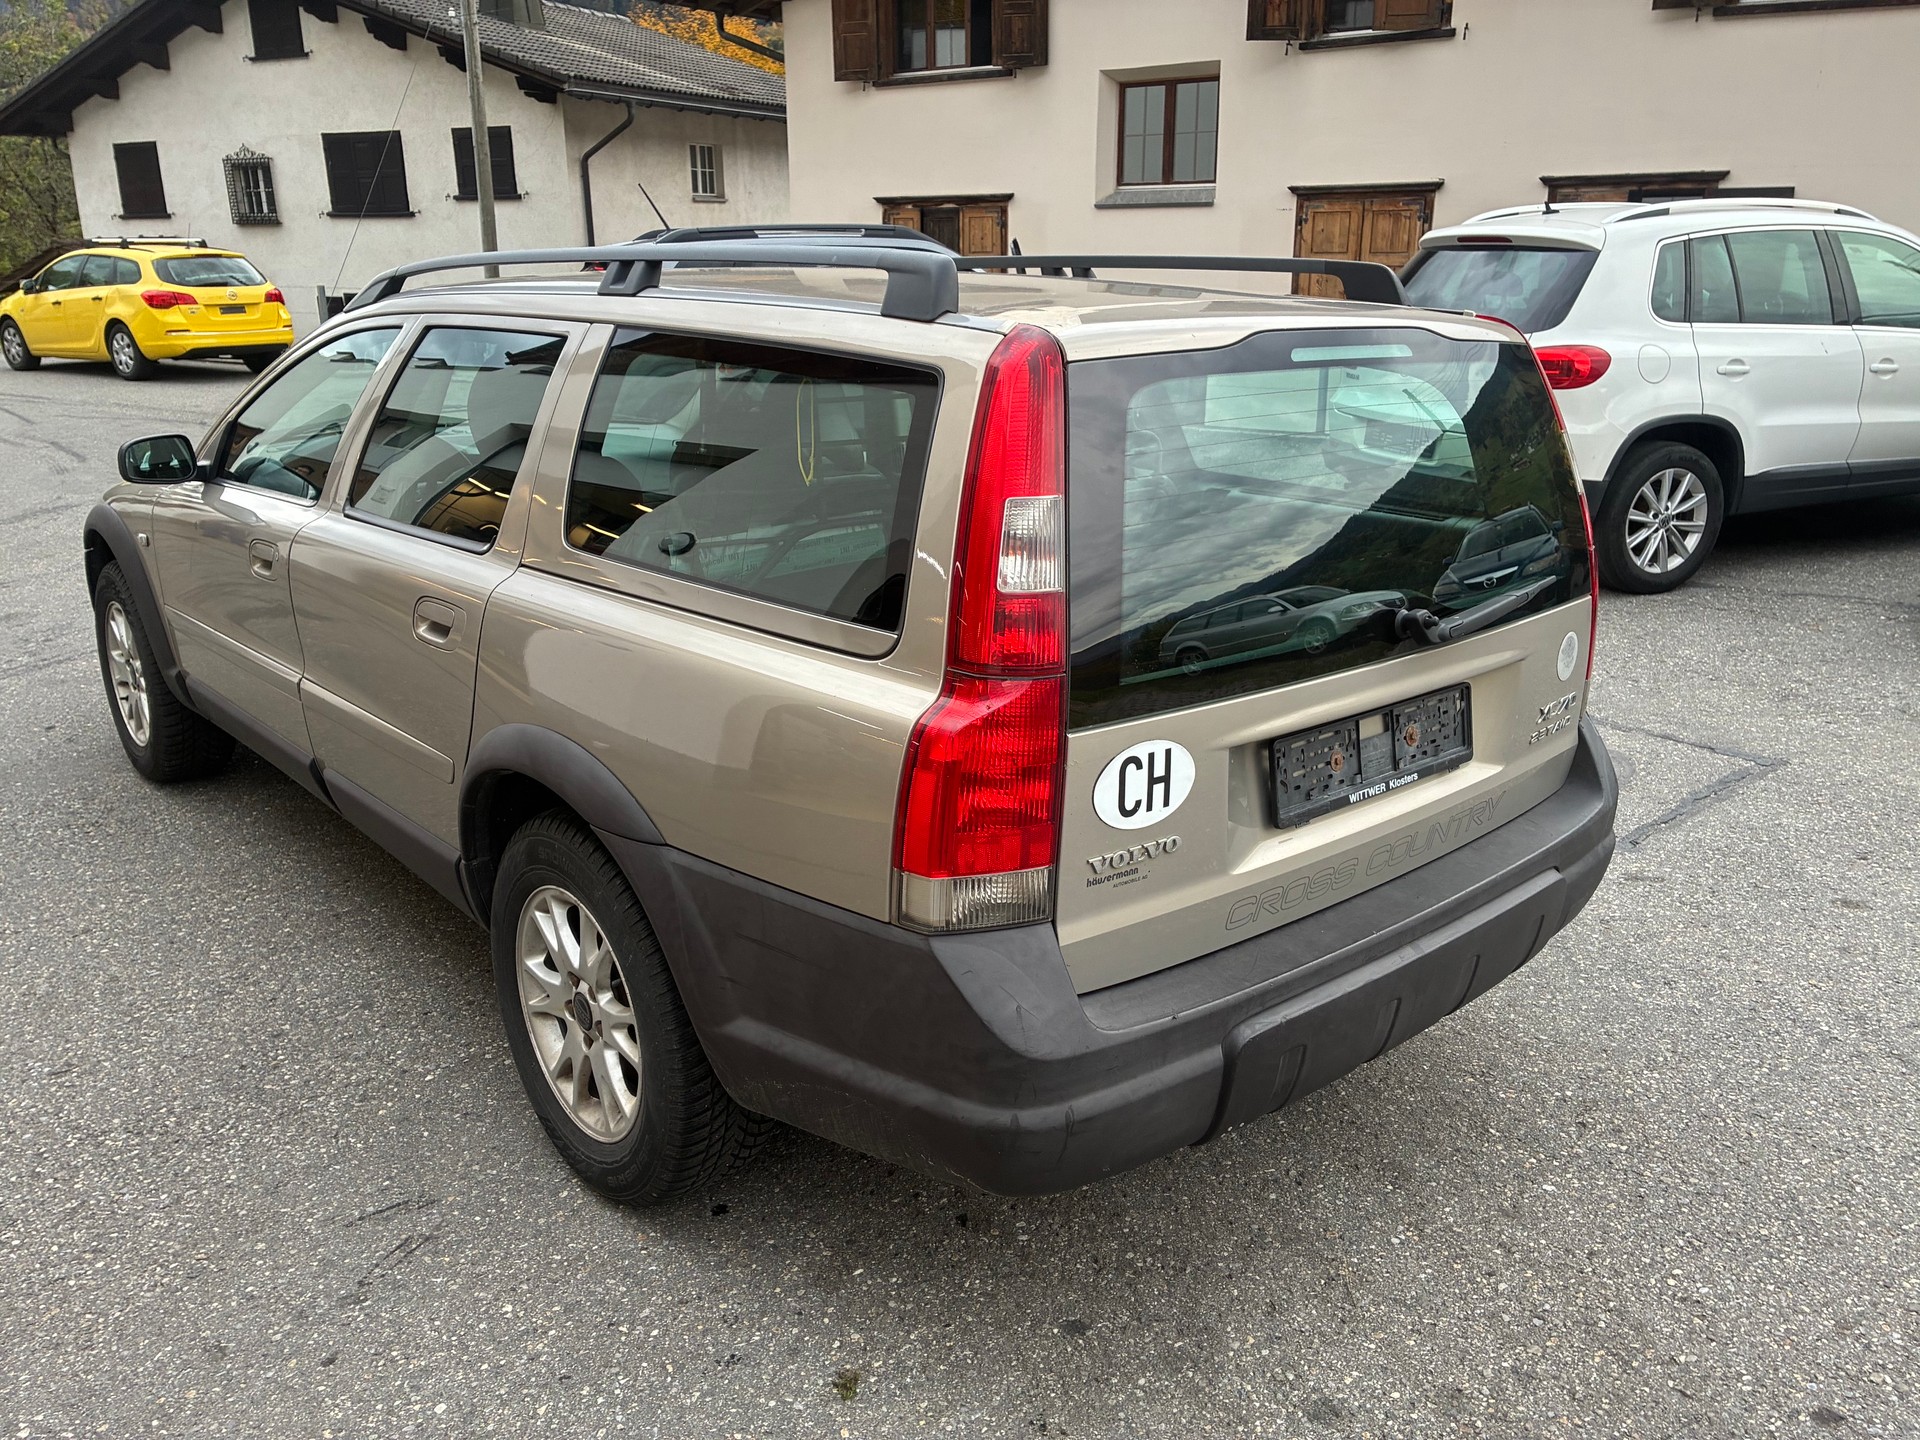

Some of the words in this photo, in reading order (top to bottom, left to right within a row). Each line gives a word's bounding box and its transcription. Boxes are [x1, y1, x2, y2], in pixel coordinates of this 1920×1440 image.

[1118, 747, 1172, 818] CH
[1348, 783, 1386, 804] WITTWER
[1389, 772, 1419, 790] Klosters
[1086, 835, 1183, 875] VOLVO
[1224, 856, 1359, 931] CROSS
[1365, 789, 1507, 878] COUNTRY
[1086, 867, 1139, 888] häusermann
[1112, 878, 1141, 889] AUTOMOBILE
